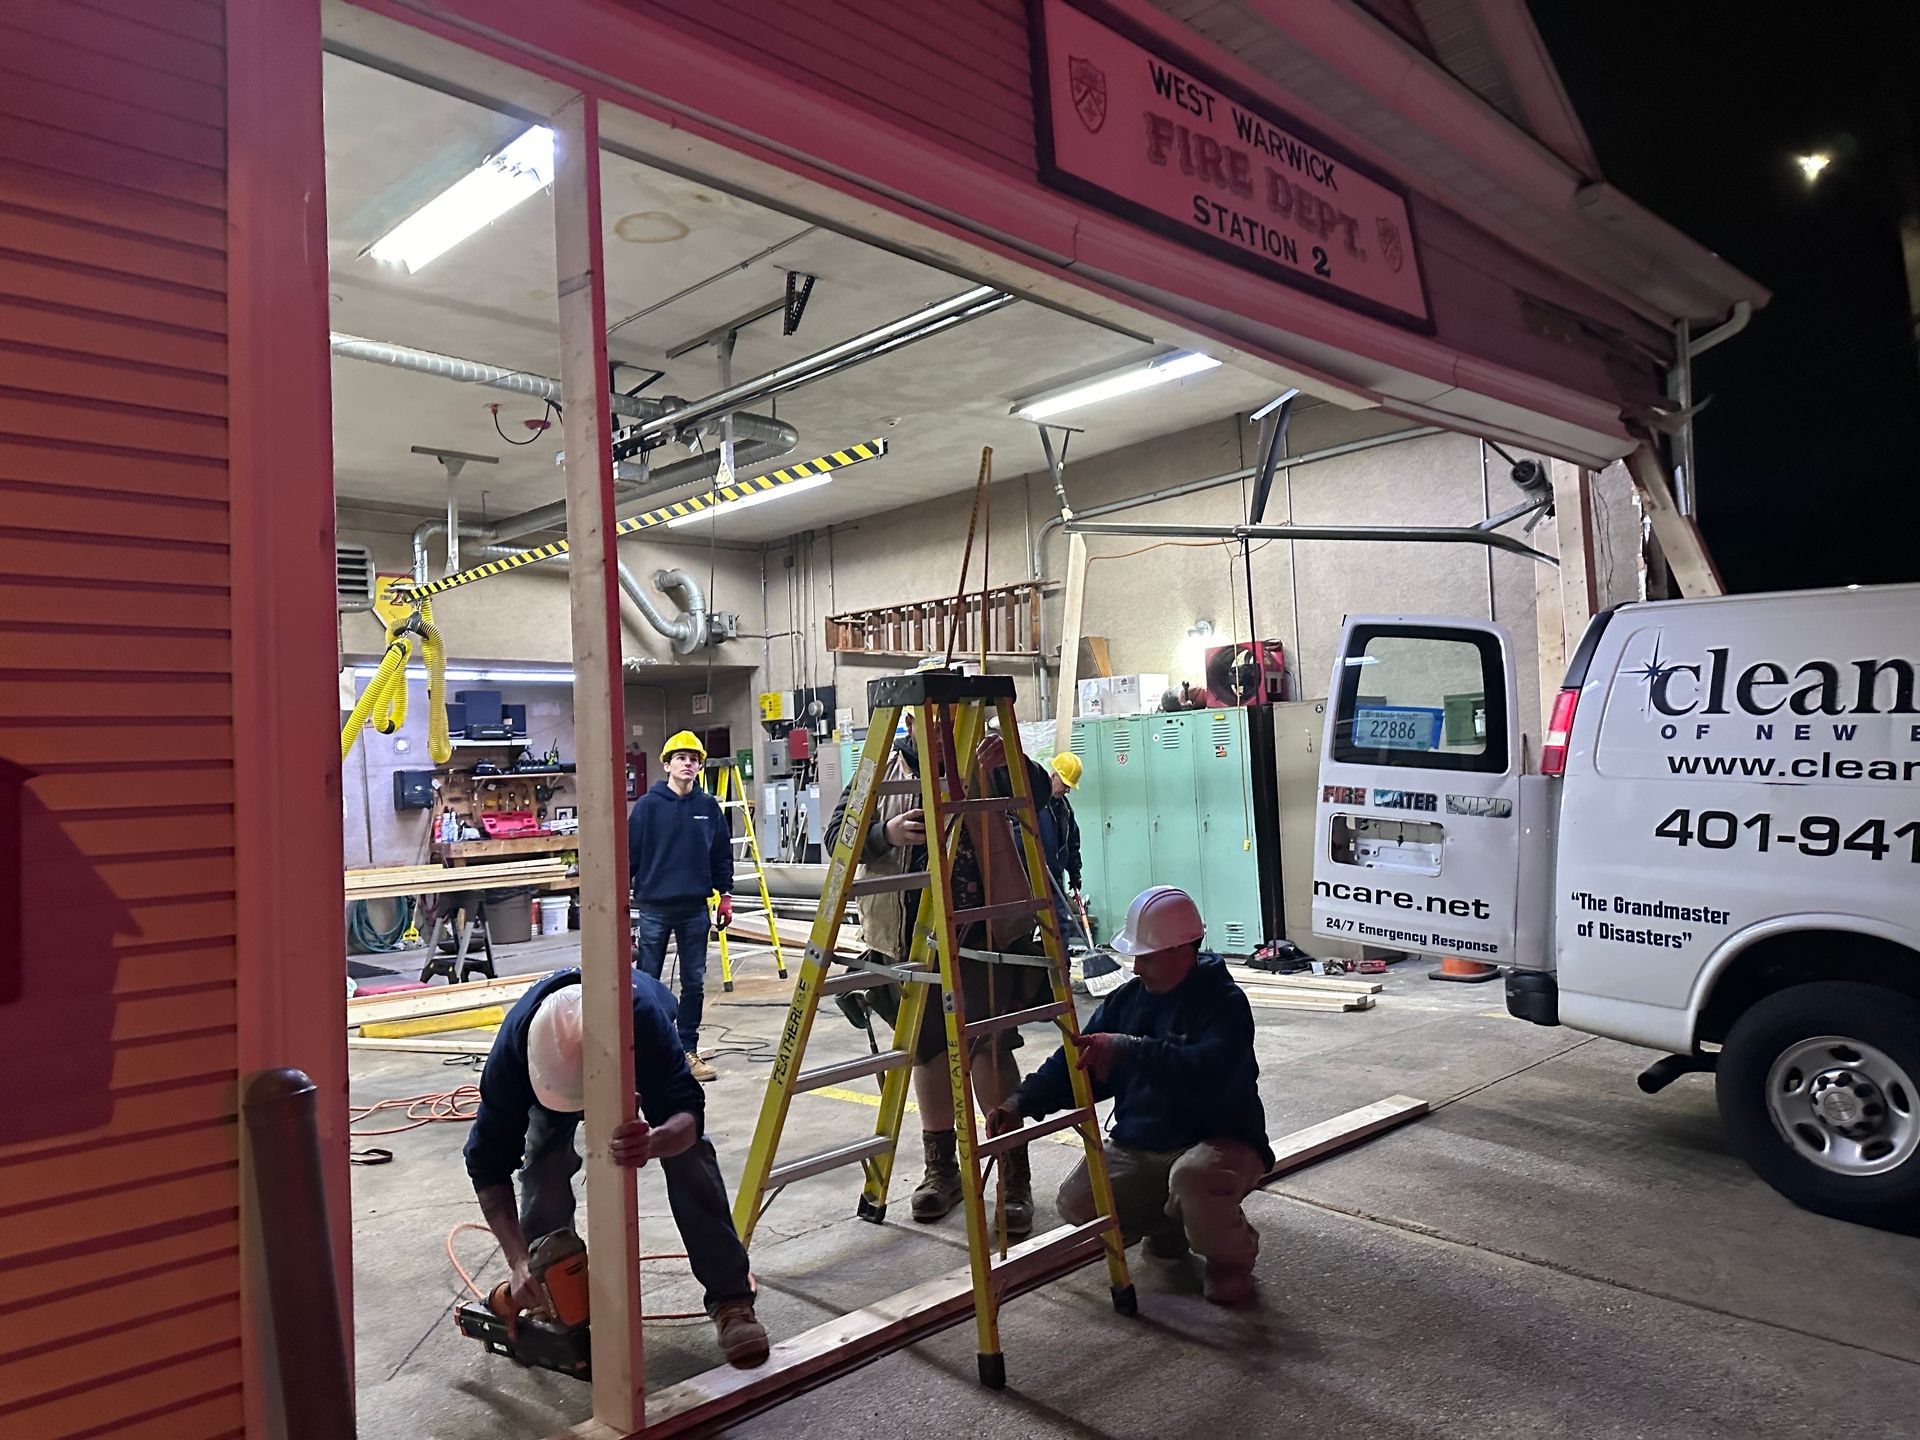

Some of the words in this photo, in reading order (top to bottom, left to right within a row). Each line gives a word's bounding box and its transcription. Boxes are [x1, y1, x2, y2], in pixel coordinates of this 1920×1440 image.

[1148, 59, 1215, 123] WEST
[1232, 107, 1339, 191] WARWICK
[1145, 112, 1254, 198] FIRE
[1264, 166, 1368, 262] DEPT.
[1193, 194, 1298, 265] STATION
[1312, 245, 1331, 278] 2
[1651, 647, 1920, 716] clean
[1370, 720, 1416, 739] 22886
[1660, 724, 1710, 741] OF
[1756, 724, 1857, 741] NEW
[1323, 785, 1366, 805] FIRE
[1373, 789, 1438, 812] WATER
[1445, 794, 1513, 819] WIND
[1655, 808, 1920, 864] 401-941
[1313, 880, 1490, 920] ncare.net
[1571, 891, 1607, 911] “The
[1614, 896, 1730, 925] Grandmaster
[1326, 917, 1354, 931] 24/7
[1358, 922, 1427, 946] Emergency
[1432, 933, 1498, 953] Response
[1577, 921, 1594, 938] of
[1600, 922, 1692, 949] Disasters”
[948, 1040, 962, 1089] CARE
